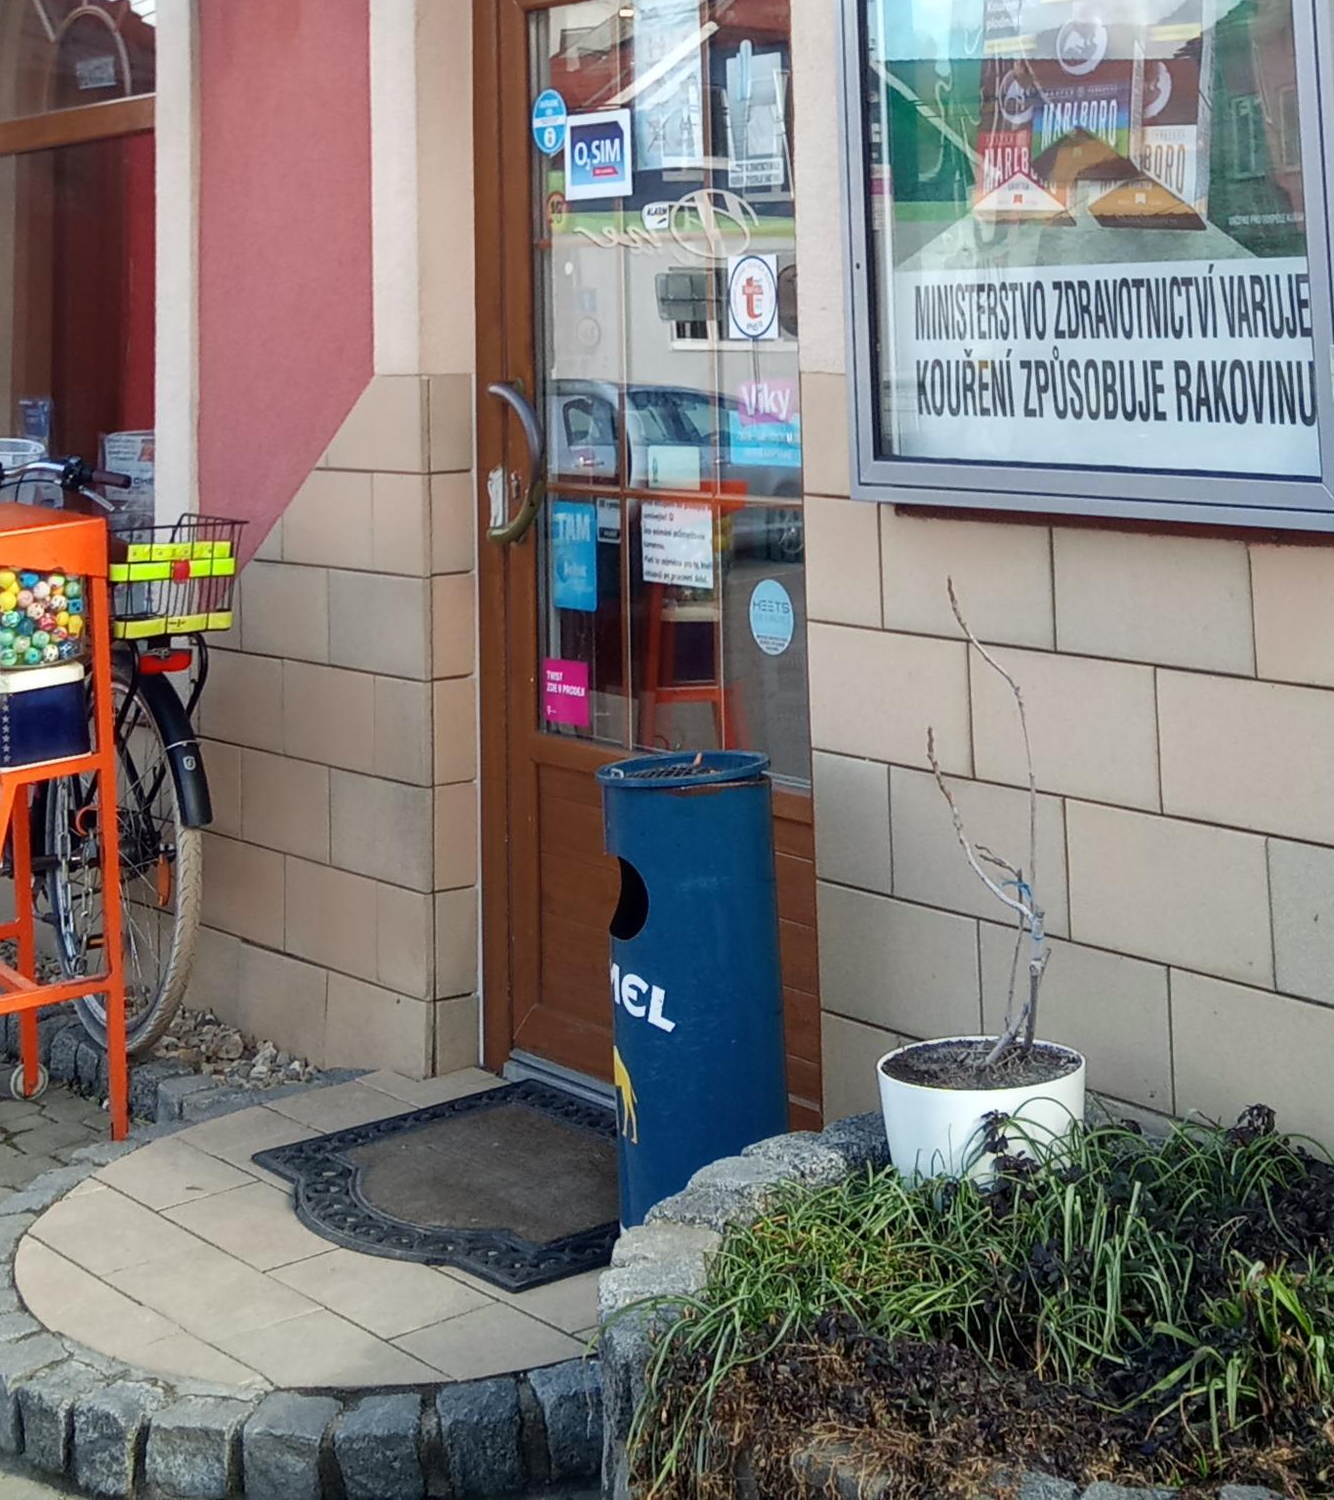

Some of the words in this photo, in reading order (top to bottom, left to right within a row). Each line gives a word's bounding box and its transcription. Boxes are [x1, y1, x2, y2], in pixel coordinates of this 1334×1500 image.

[1041, 99, 1118, 151] MARLBORO
[591, 137, 621, 165] SIM
[914, 279, 1047, 342] MINISTERSTVO
[1053, 264, 1218, 341] ZDRAVOTNICTVÍ
[1222, 272, 1314, 339] VARUJE
[741, 383, 791, 421] Viky
[915, 349, 1015, 420] KOUŘENÍ
[1019, 345, 1169, 423] ZPŮSOBUJE
[1175, 359, 1320, 426] RAKOVINU
[554, 512, 591, 542] TAM
[753, 599, 790, 614] HEETS
